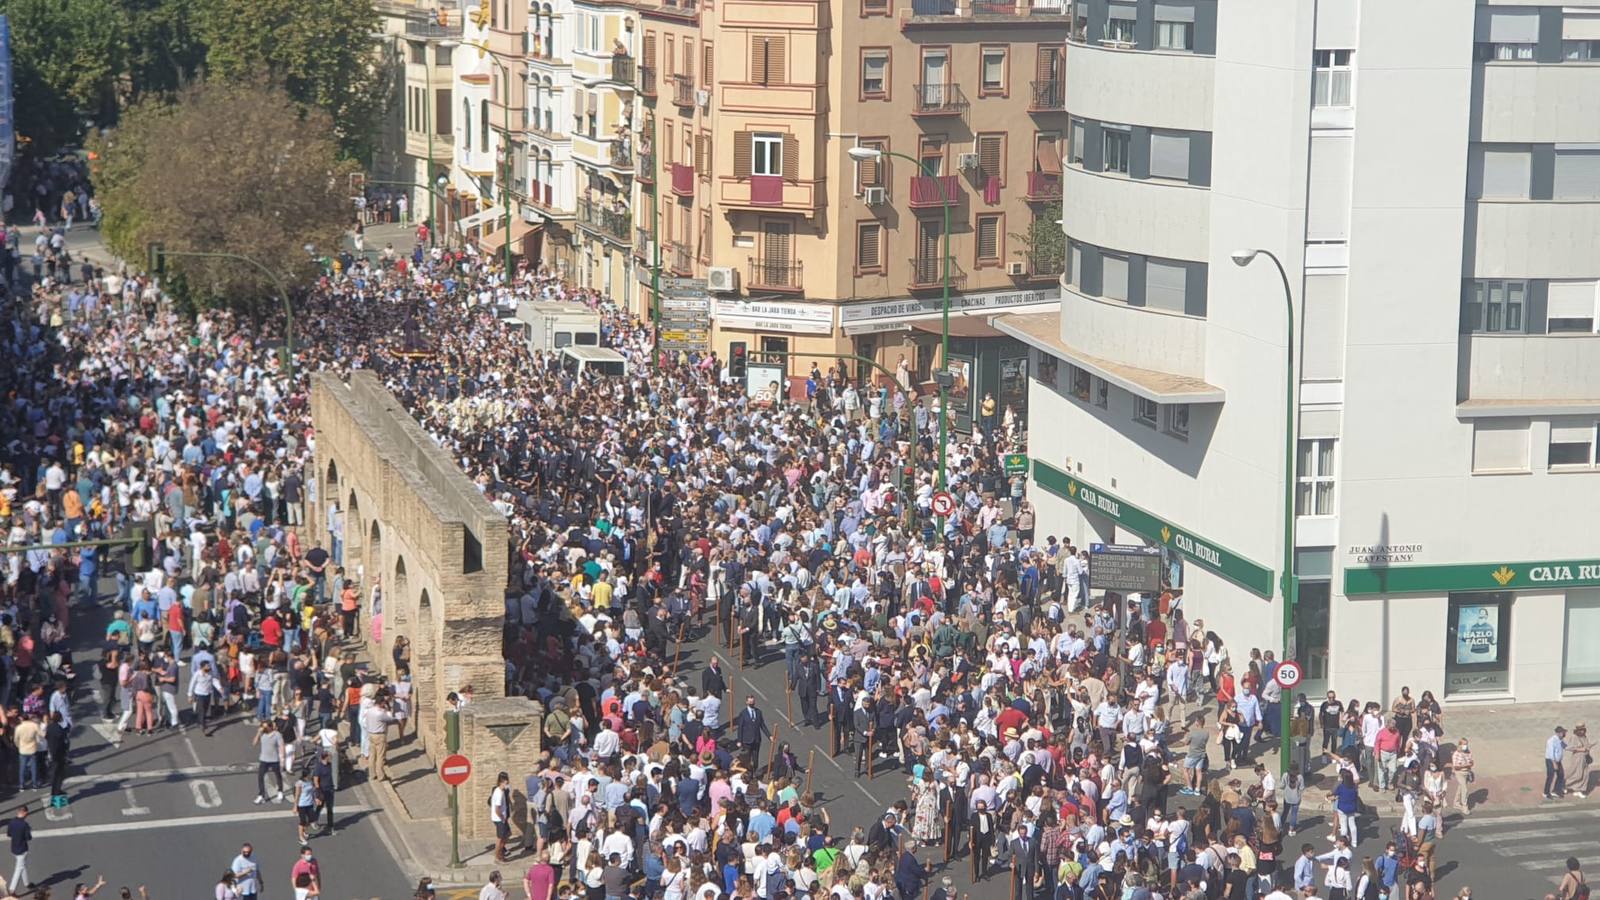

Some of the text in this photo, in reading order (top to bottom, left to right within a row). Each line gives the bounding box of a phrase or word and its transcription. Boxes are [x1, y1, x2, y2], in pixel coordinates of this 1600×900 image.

[871, 304, 897, 316] DESPACHO
[897, 303, 905, 314] DE
[906, 302, 922, 313] VINOS
[961, 297, 986, 308] CHACINAS
[994, 293, 1023, 305] PRODUCTOS
[780, 307, 796, 315] TIENDA
[1080, 488, 1121, 518] CAJA RURAL
[1175, 533, 1222, 567] CAJA RURAL
[1349, 544, 1423, 554] JUAN ANTONIO
[1357, 554, 1414, 563] CAVESTANY
[1529, 565, 1574, 582] CAJA
[1463, 630, 1492, 639] HAZLO
[1281, 670, 1296, 679] 50
